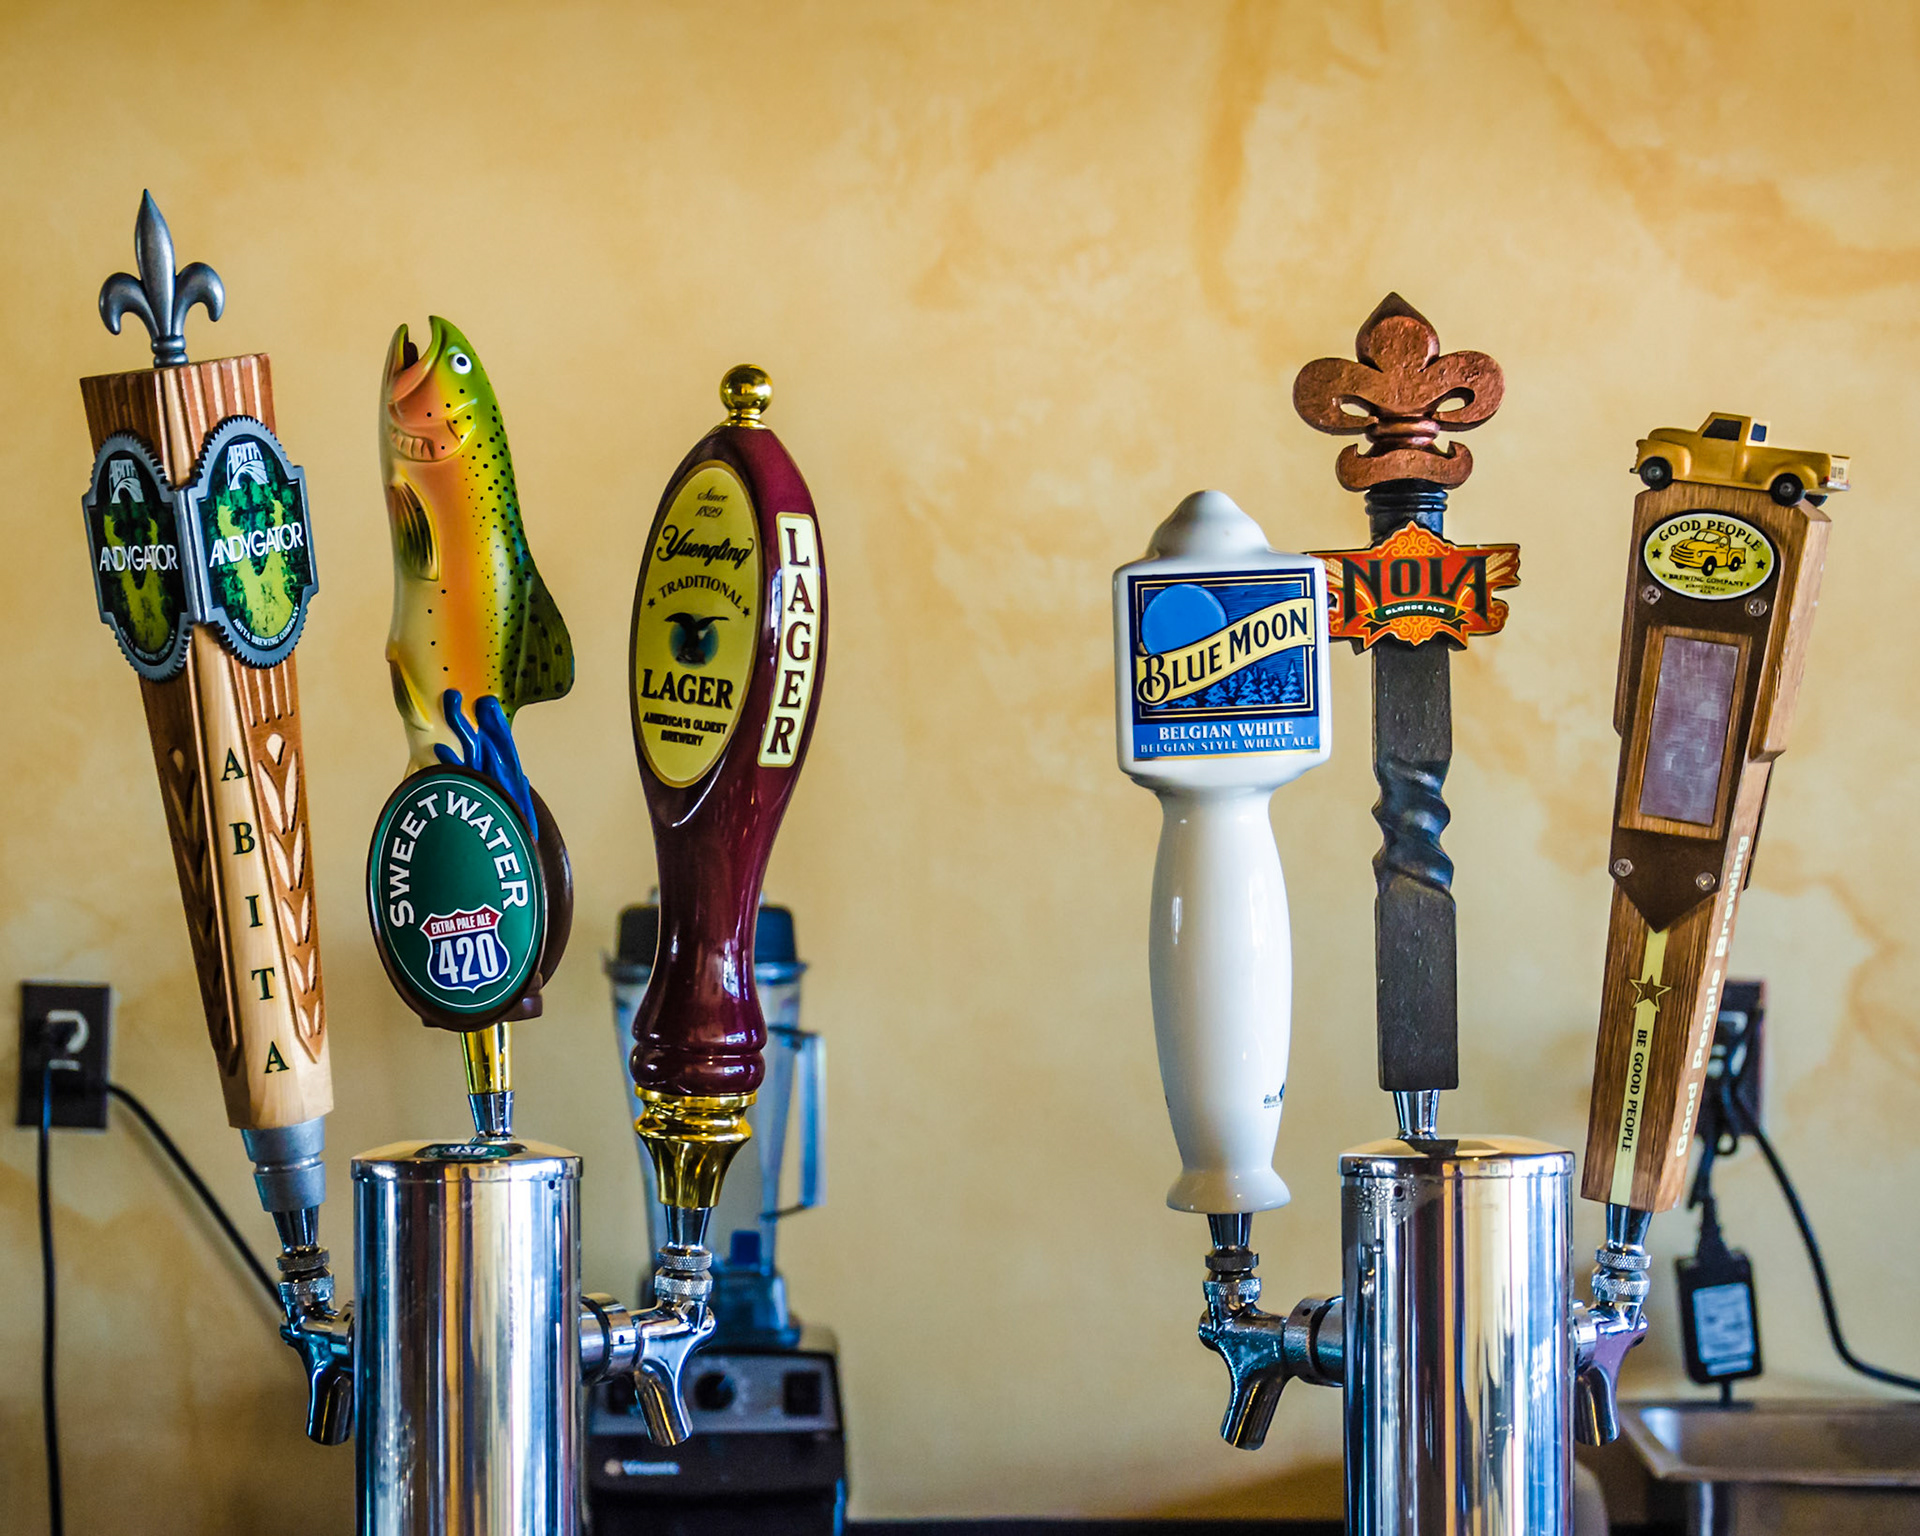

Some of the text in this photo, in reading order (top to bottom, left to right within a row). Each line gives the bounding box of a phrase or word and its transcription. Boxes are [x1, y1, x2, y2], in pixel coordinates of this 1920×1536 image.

[226, 441, 262, 487] ABITA
[99, 544, 179, 571] ANDYGATOR
[209, 522, 304, 568] ANDYGATOR
[656, 525, 755, 570] Yuengling
[1659, 520, 1763, 552] GOOD PEOPLE
[658, 575, 742, 609] TRADITIONAL
[1339, 555, 1491, 631] NOLA
[1669, 573, 1744, 587] BREWING COMPANY
[1385, 604, 1446, 616] BLONDE ALE
[767, 527, 815, 754] LAGER
[1138, 606, 1308, 705] BLUE MOON
[641, 668, 734, 710] LAGER
[643, 711, 728, 734] AMERICA'S OLDEST
[1140, 735, 1315, 753] BELGIAN STYLE WHEAT ALE
[1159, 721, 1294, 740] BELGIAN WHITE
[390, 790, 529, 928] SWEETWATER
[221, 747, 290, 1075] ABITA
[431, 912, 492, 935] EXTRA PALE ALE
[438, 933, 499, 984] 420
[1675, 835, 1749, 1158] Good People Brewing
[1621, 1029, 1648, 1153] BE GOOD PEOPLE
